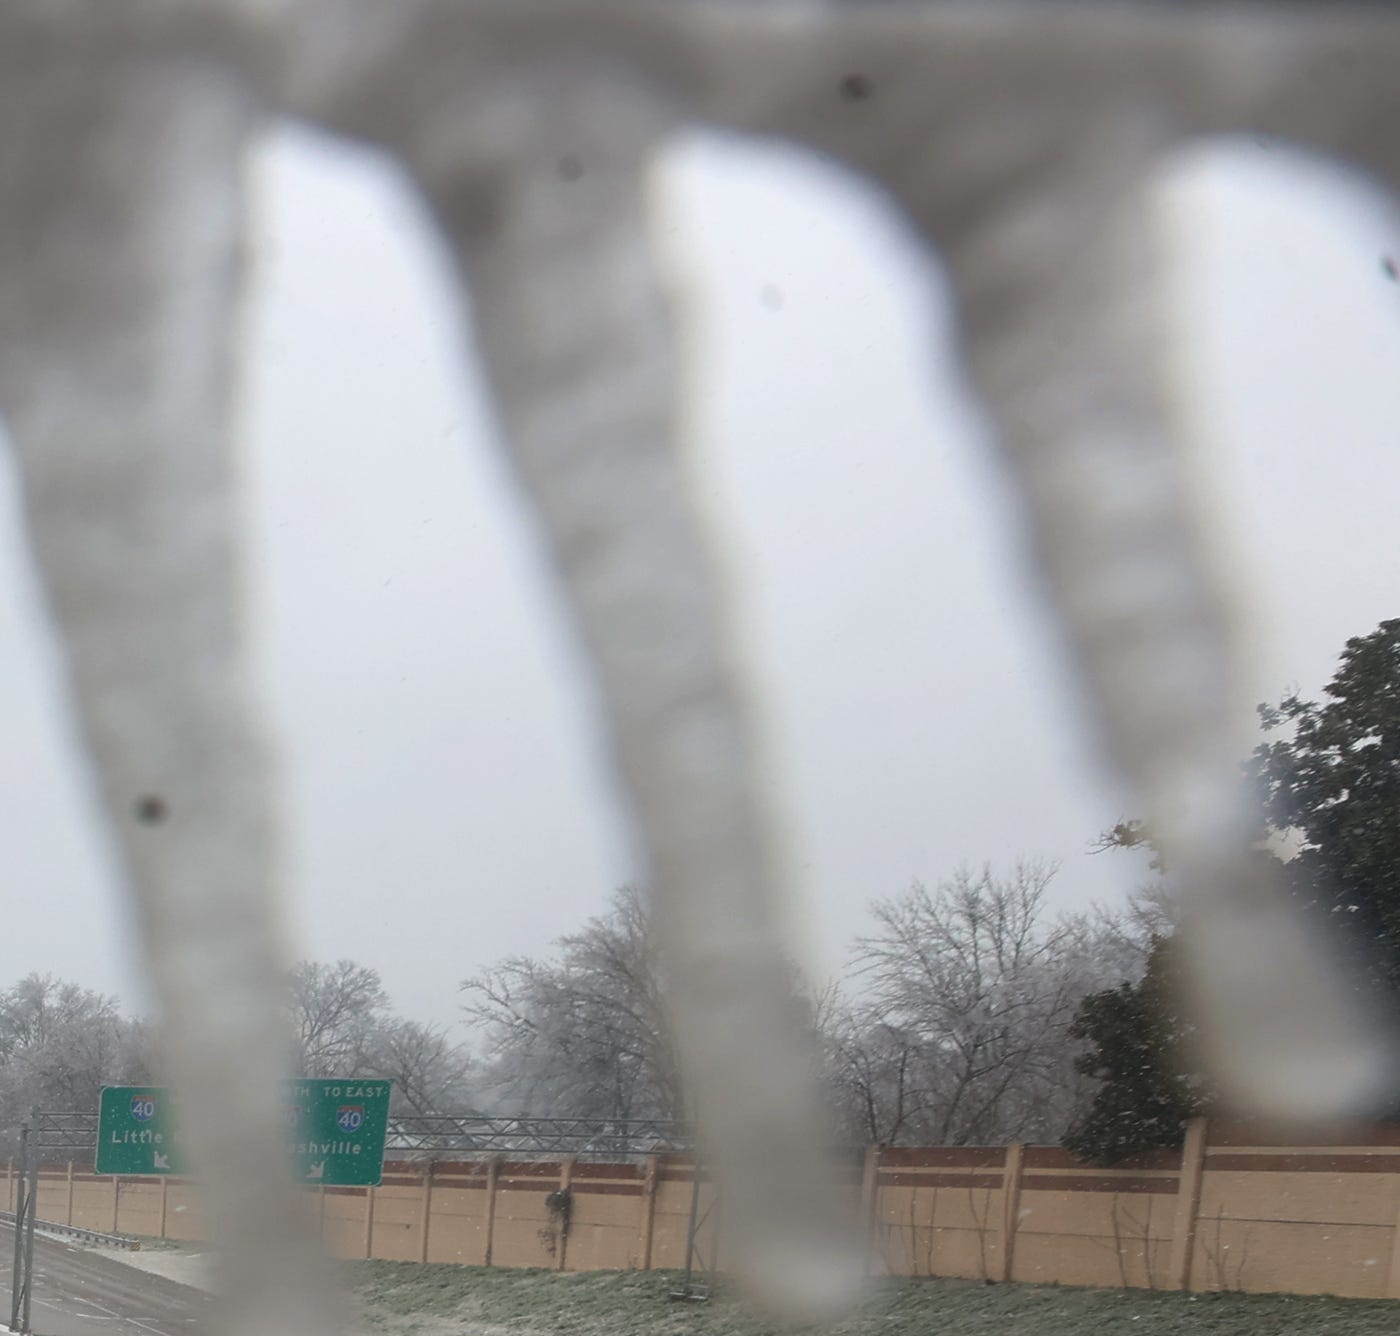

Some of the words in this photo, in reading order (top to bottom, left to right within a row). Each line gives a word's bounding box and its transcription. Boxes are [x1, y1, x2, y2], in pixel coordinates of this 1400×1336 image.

[323, 1087, 341, 1097] TO
[345, 1087, 384, 1098] EAST
[133, 1101, 154, 1117] 40
[339, 1112, 361, 1128] 40
[111, 1128, 163, 1144] Little
